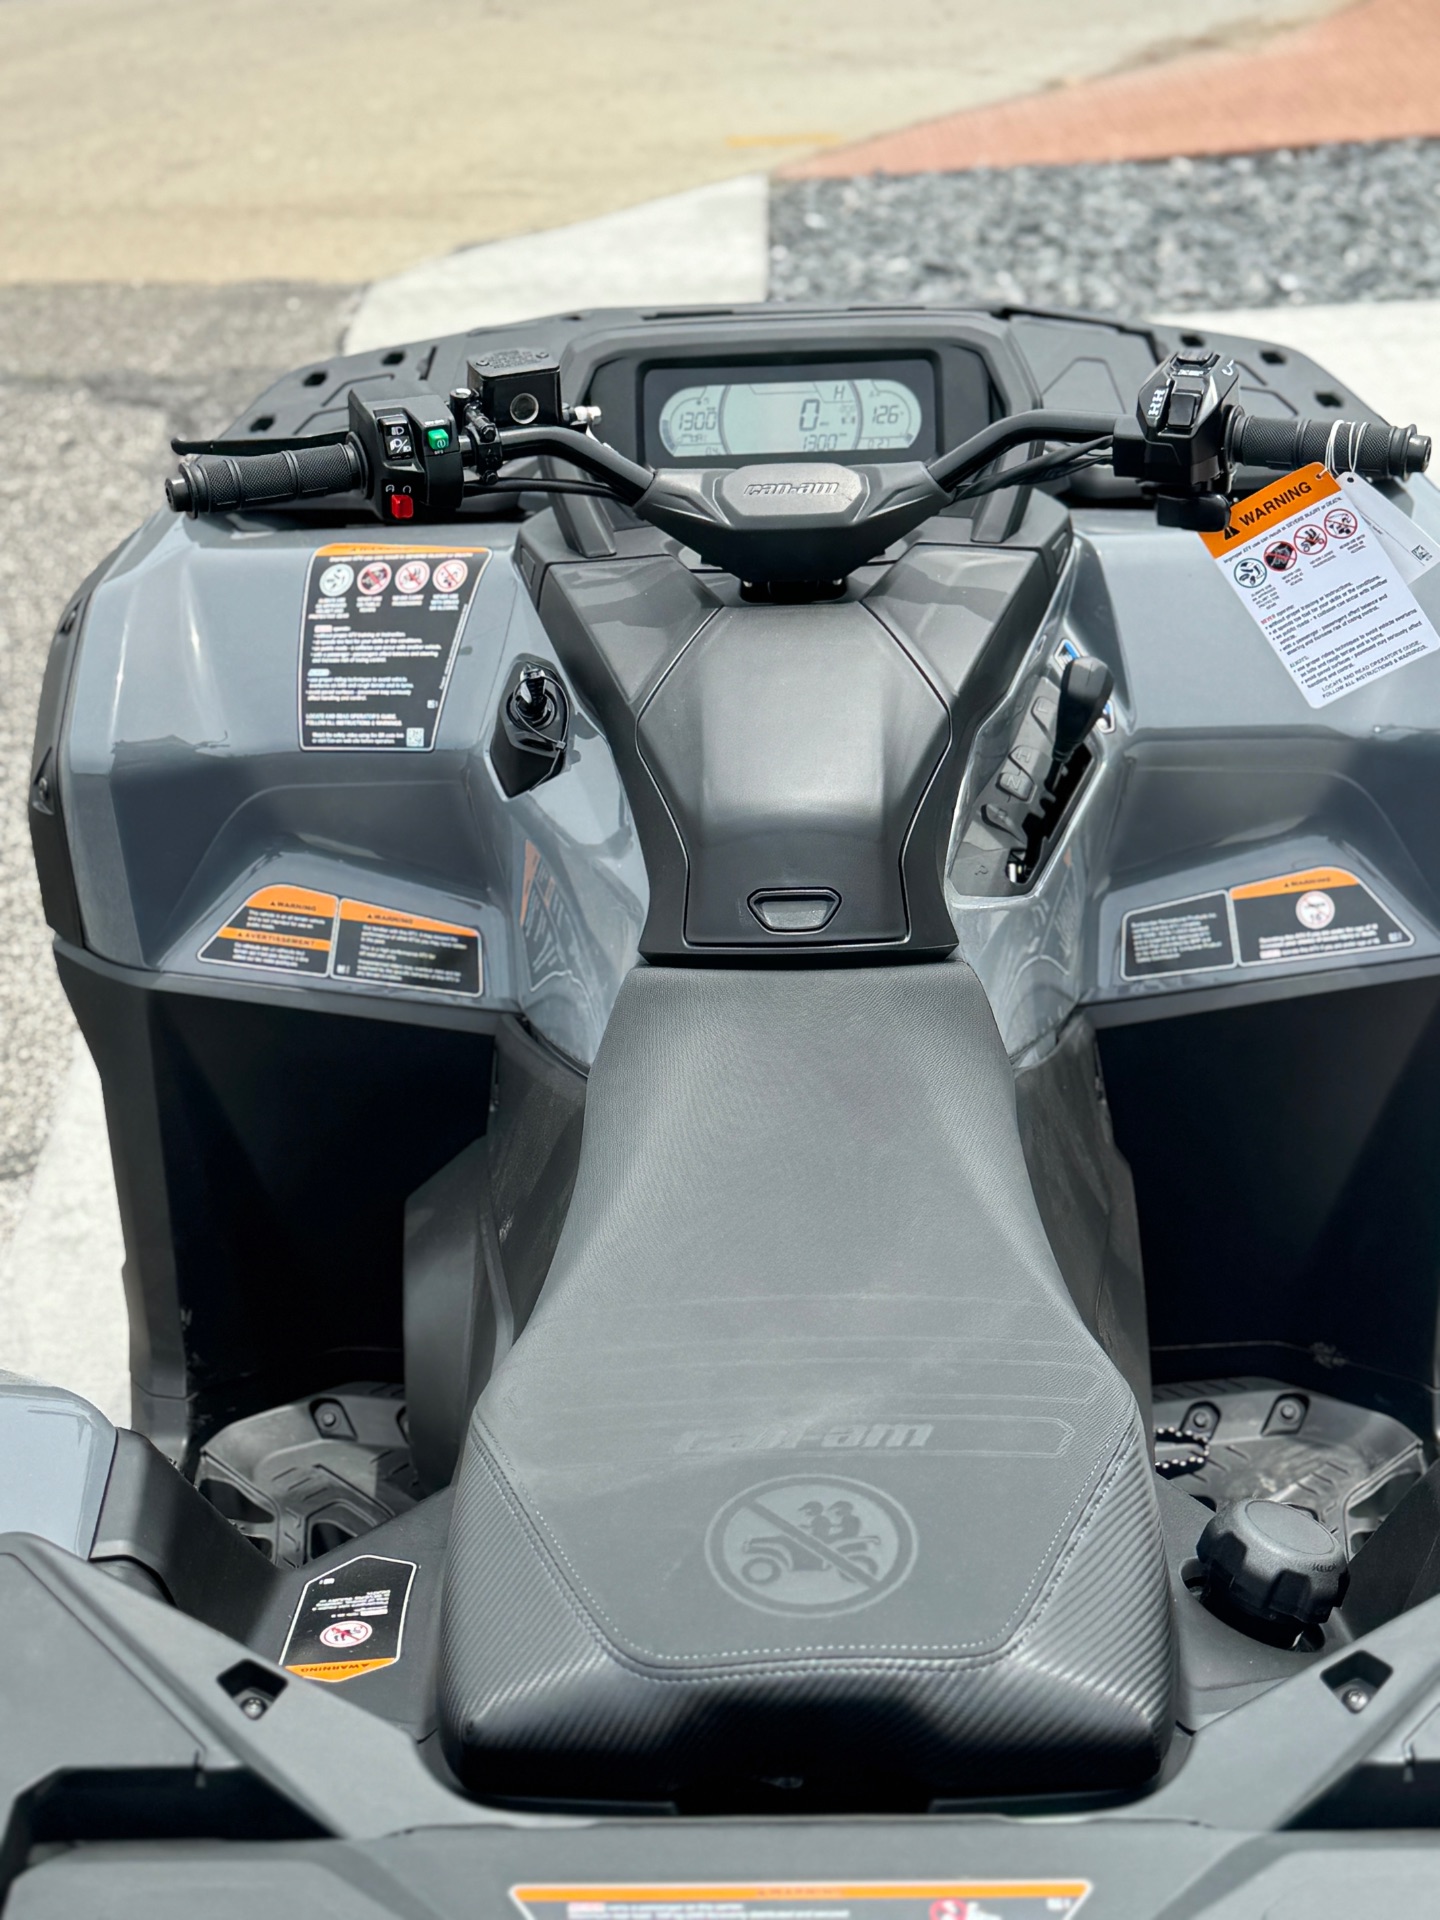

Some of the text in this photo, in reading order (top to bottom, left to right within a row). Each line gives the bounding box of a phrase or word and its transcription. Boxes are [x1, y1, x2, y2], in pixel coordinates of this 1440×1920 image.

[834, 385, 845, 400] H
[679, 410, 717, 431] 1300
[799, 398, 820, 432] 0
[744, 482, 839, 496] can-am
[1239, 481, 1312, 527] WARNING
